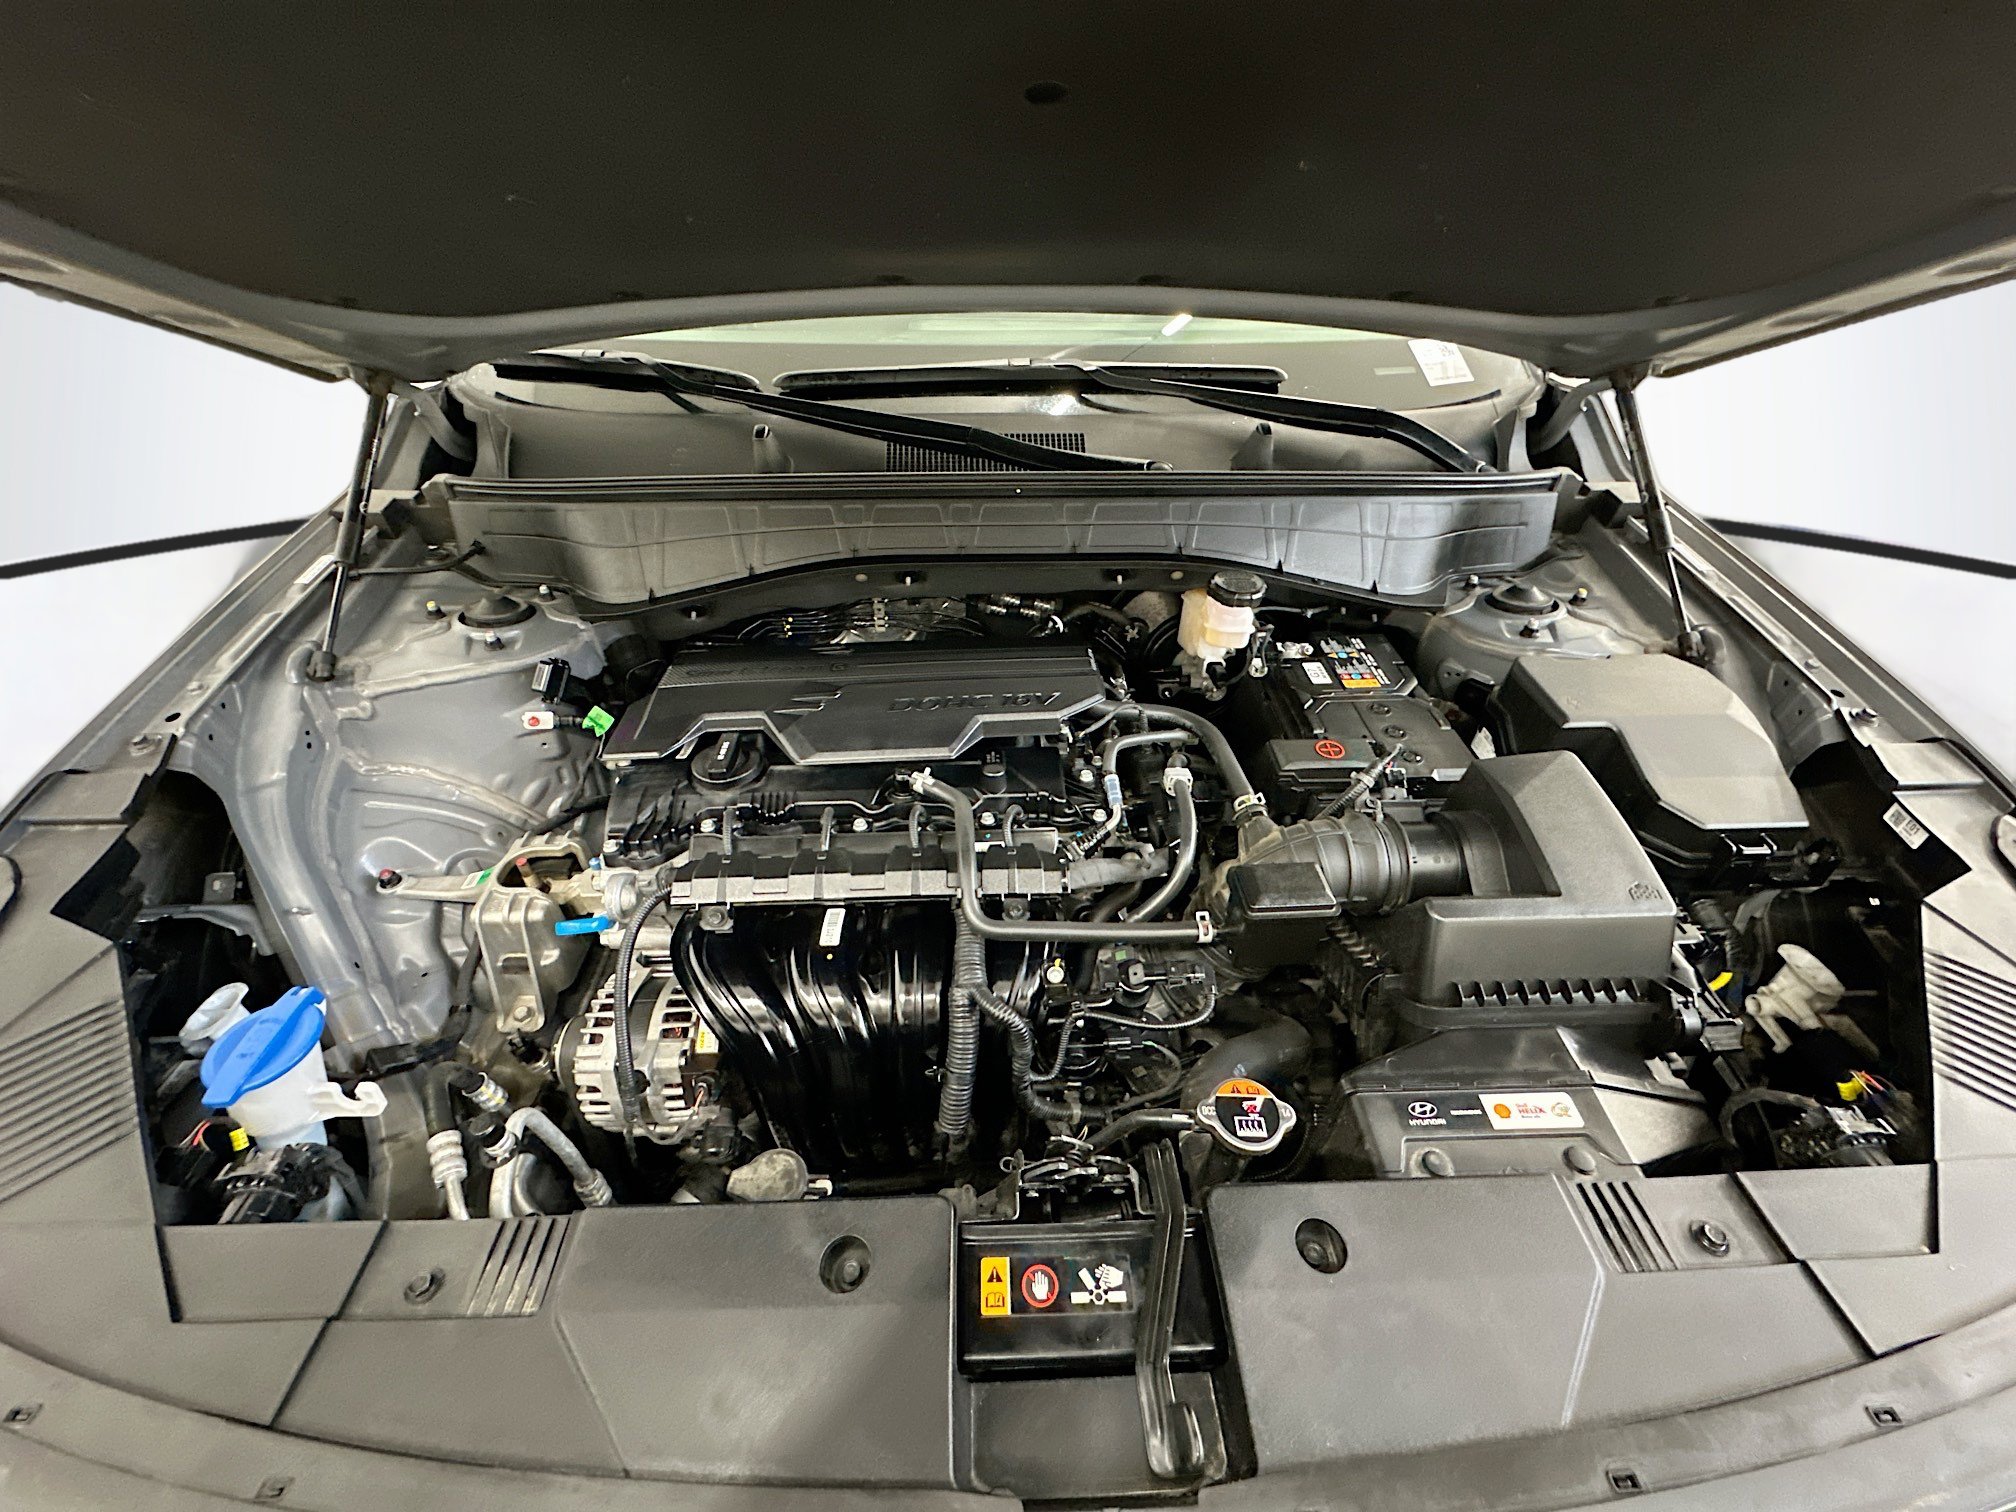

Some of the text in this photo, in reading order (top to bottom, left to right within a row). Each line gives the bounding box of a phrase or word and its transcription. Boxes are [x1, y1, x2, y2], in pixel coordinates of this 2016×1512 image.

[887, 691, 1061, 712] DOHC 16V
[1408, 1118, 1447, 1126] HYUNDAI
